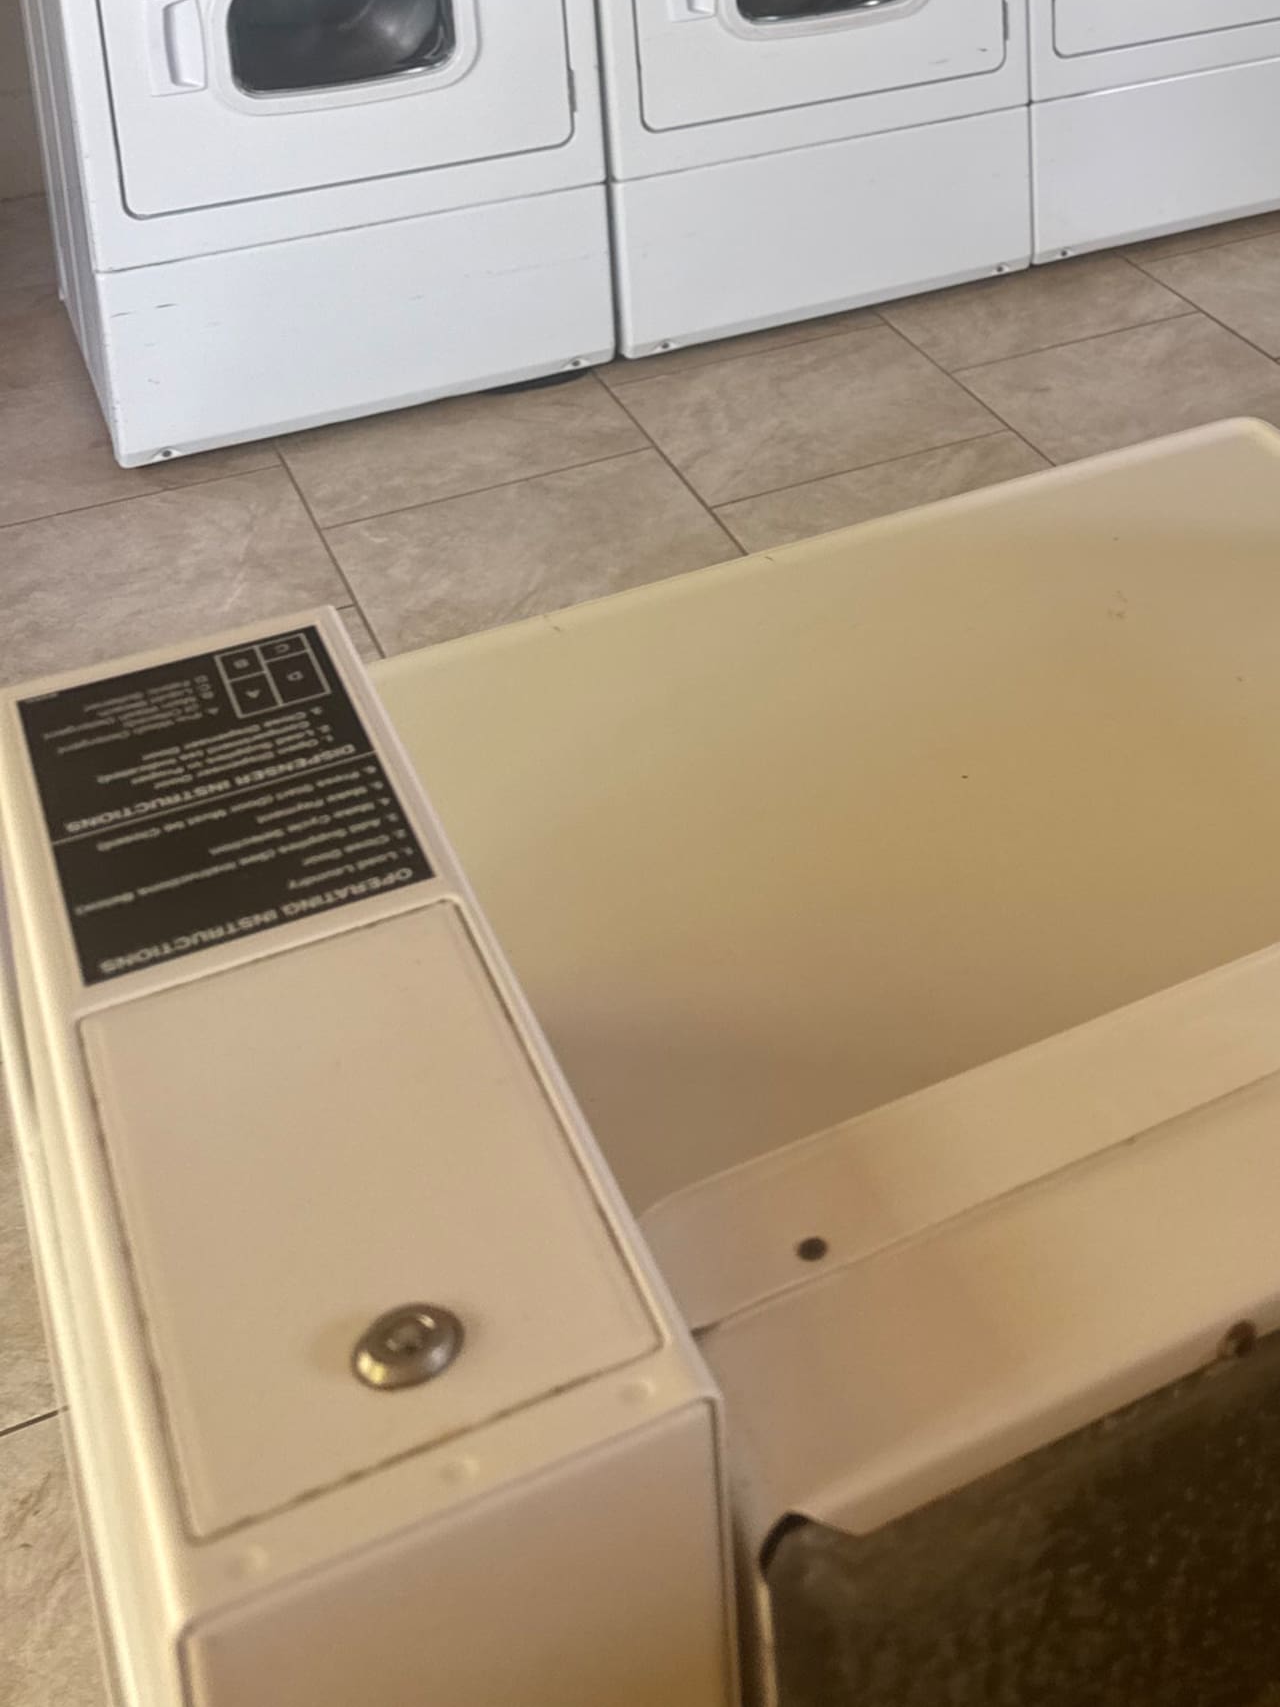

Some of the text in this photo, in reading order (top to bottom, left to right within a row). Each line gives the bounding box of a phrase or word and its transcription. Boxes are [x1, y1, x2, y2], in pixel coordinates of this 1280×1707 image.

[275, 644, 290, 653] C
[234, 659, 249, 668] B
[287, 671, 303, 681] D
[246, 690, 259, 698] A
[66, 744, 355, 832] DISPENSER INSTRUCTIONS
[100, 868, 412, 973] OPERATING INSTRUCTIONS
